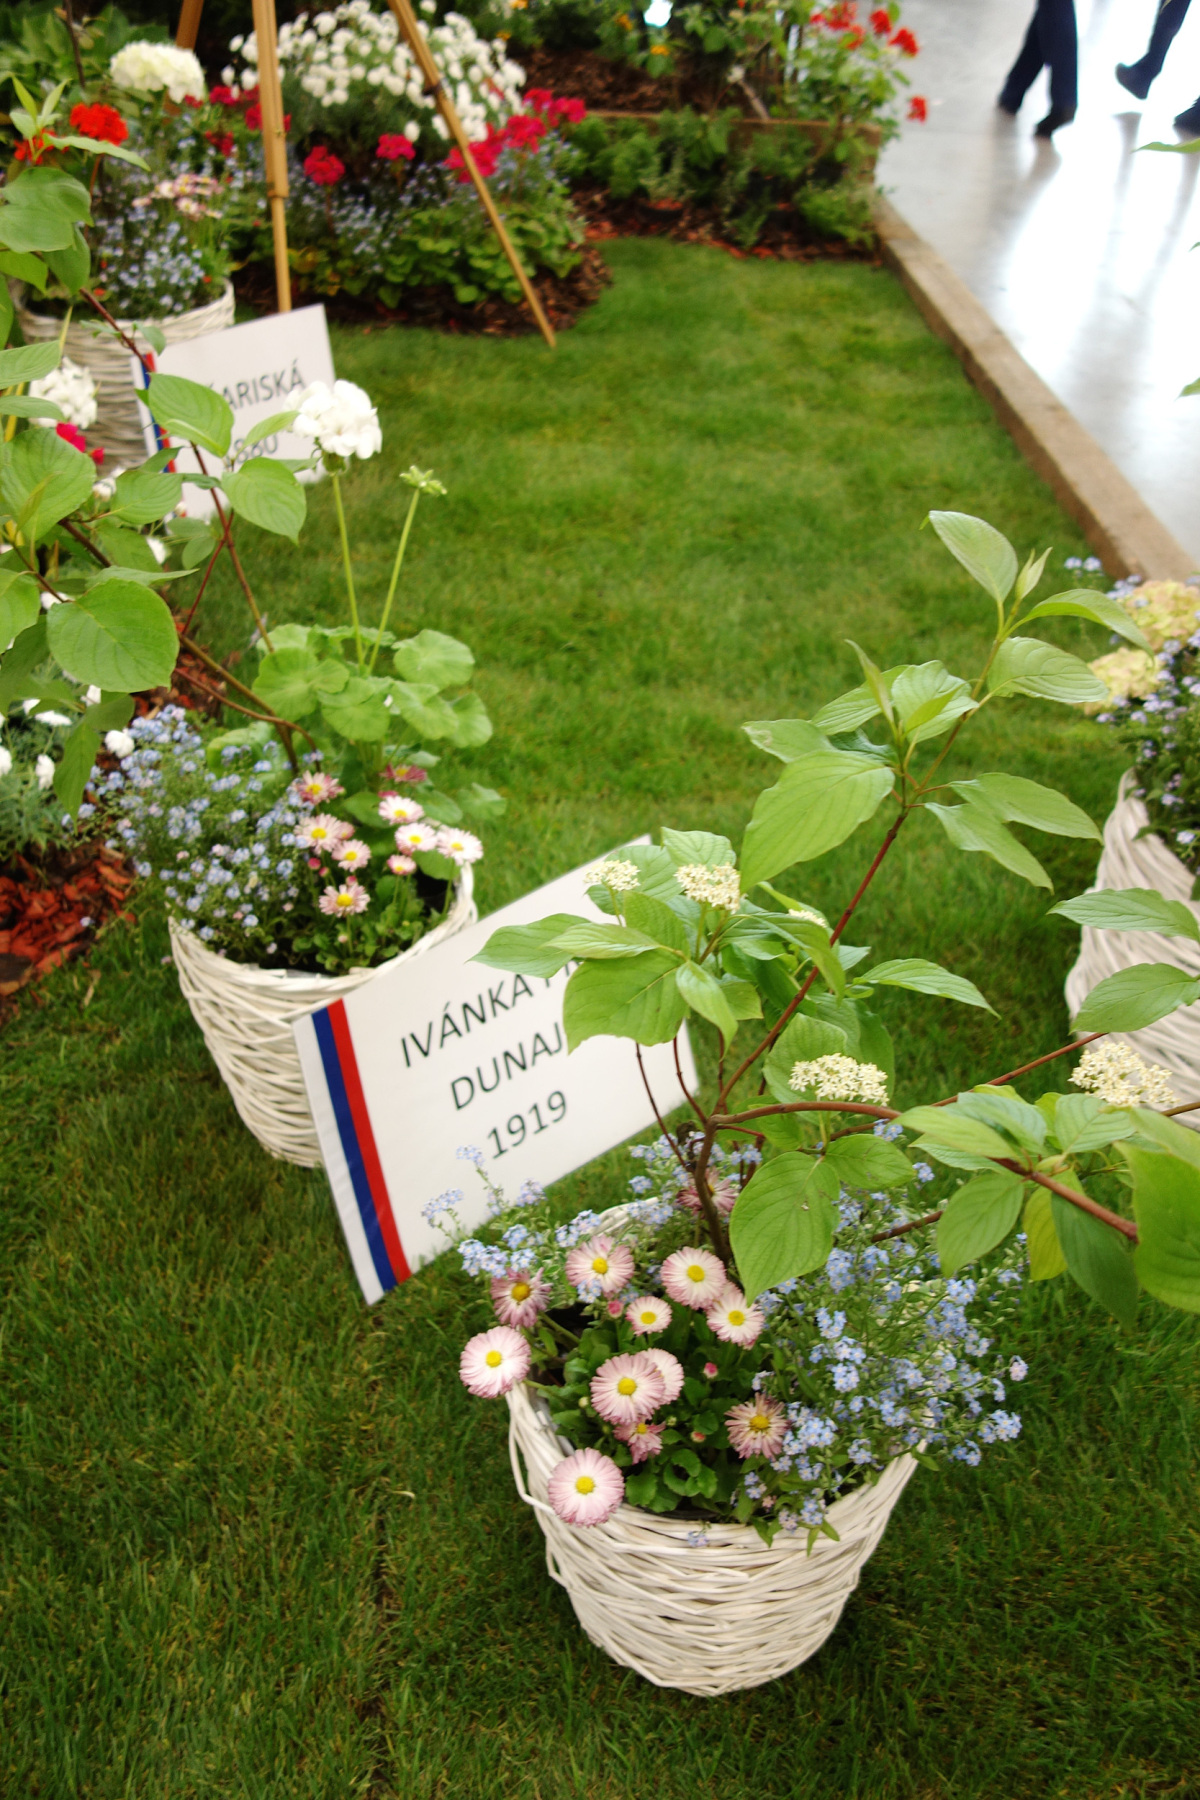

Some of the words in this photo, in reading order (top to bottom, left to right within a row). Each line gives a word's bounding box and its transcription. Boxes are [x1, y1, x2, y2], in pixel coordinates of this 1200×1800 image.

[209, 358, 306, 410] ARISKÁ
[401, 973, 533, 1068] IVÁNKA
[487, 1090, 567, 1159] 1919
